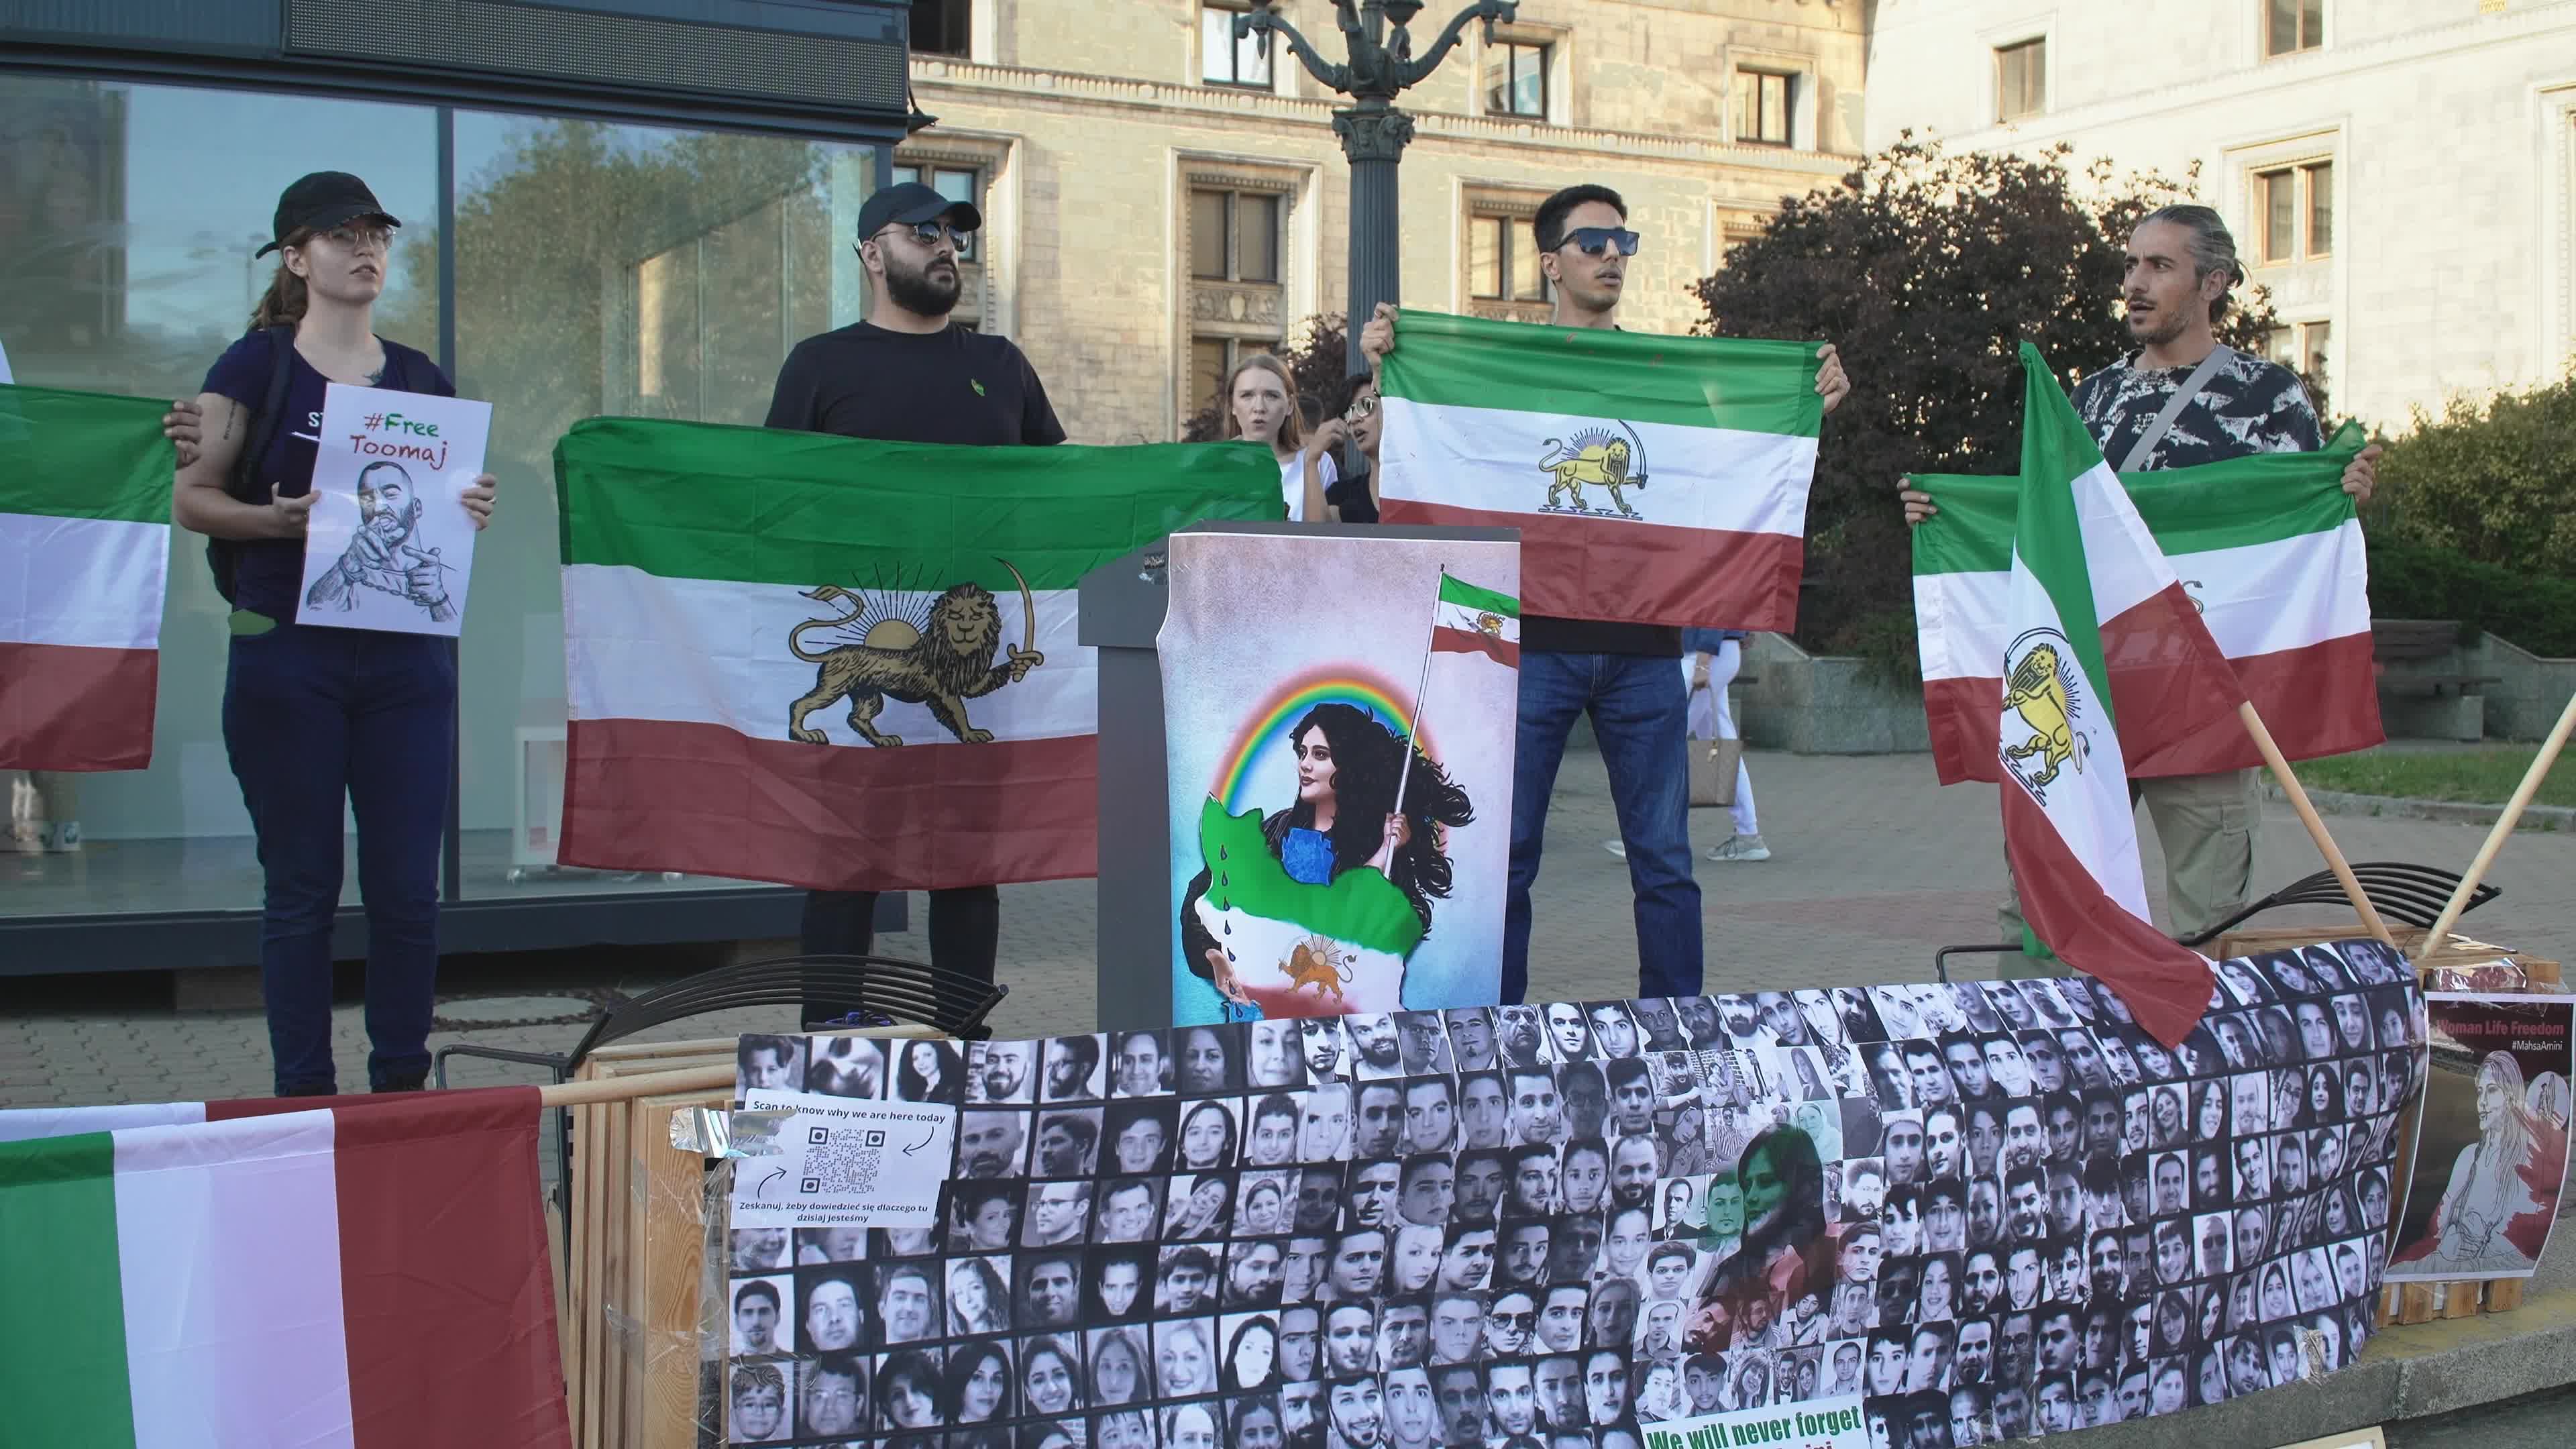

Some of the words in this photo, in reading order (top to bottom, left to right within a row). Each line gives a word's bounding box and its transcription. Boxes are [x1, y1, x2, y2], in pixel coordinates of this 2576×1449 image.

[363, 412, 440, 437] #Free
[349, 434, 449, 470] Toomaj
[2436, 1019, 2482, 1035] Woman
[2484, 1019, 2508, 1035] Life
[2511, 1020, 2565, 1036] Freedom
[2511, 1040, 2563, 1051] #MahsaAmini
[753, 1101, 778, 1111] Scan
[796, 1104, 824, 1116] know
[827, 1108, 849, 1119] why
[852, 1111, 867, 1119] we
[869, 1112, 887, 1120] are
[890, 1111, 913, 1121] here
[916, 1113, 946, 1124] today
[739, 1202, 784, 1212] Zeskanuj,
[786, 1201, 808, 1212] żeby
[809, 1202, 861, 1210] dowiedzieć
[862, 1203, 875, 1213] się
[877, 1204, 916, 1213] dlaczego
[797, 1214, 826, 1223] dzisiaj
[827, 1214, 869, 1223] jesteśmy
[1646, 1430, 1684, 1449] We
[1686, 1422, 1729, 1449] will
[1731, 1418, 1791, 1446] never
[1795, 1406, 1862, 1438] forget
